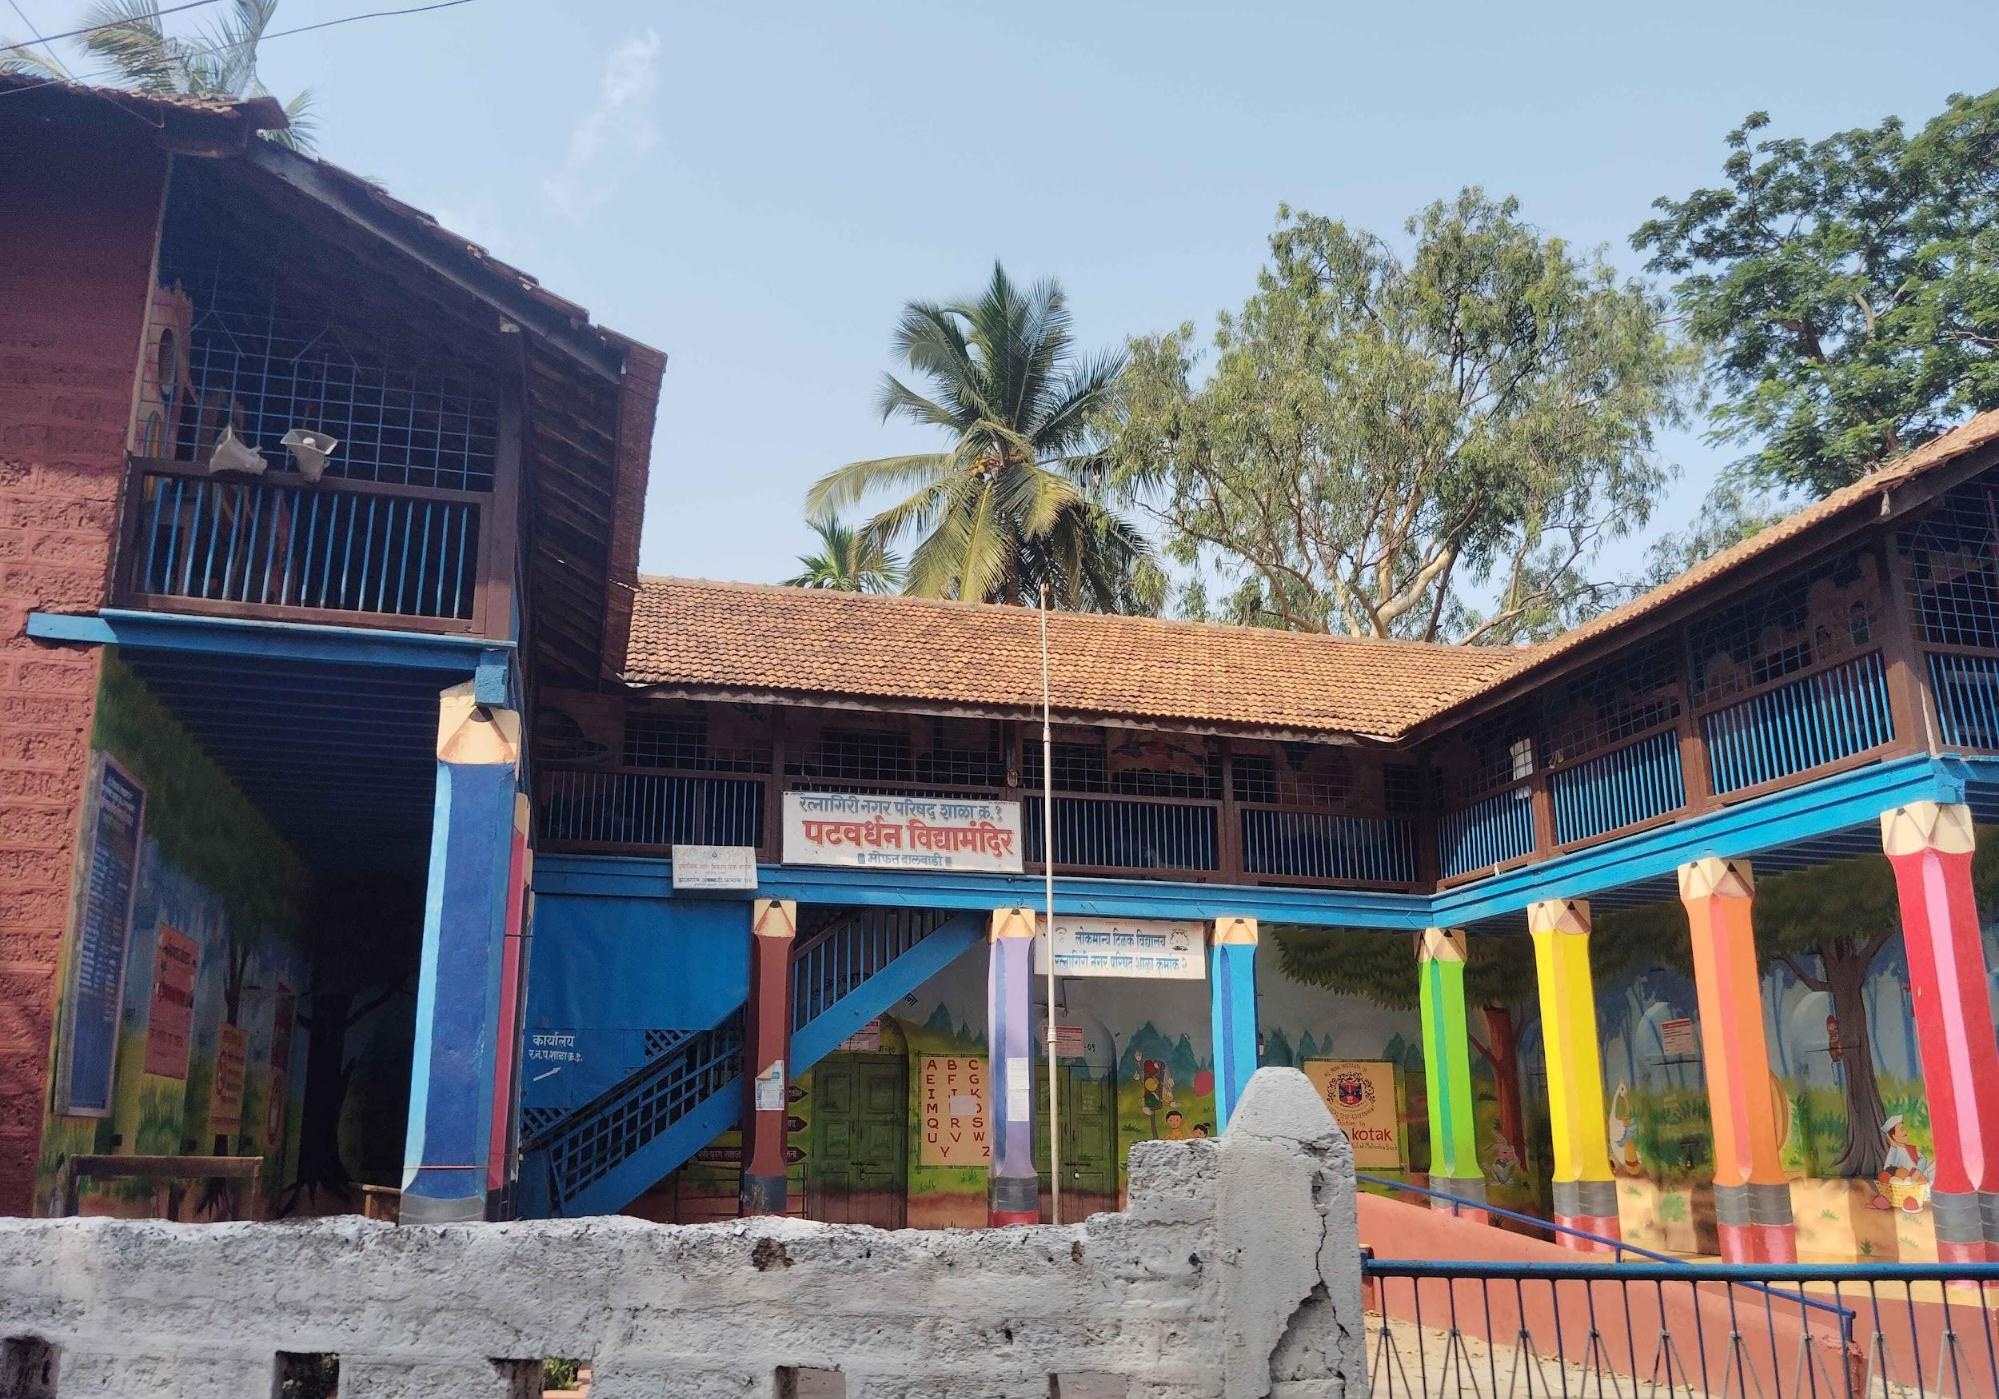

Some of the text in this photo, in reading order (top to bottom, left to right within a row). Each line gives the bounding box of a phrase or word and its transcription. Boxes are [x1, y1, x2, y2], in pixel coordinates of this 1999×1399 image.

[799, 794, 859, 815] रत्नागिरी
[861, 799, 891, 816] नगर
[893, 799, 936, 820] परिषद
[940, 803, 977, 820] शाळा
[801, 813, 1014, 858] पटवर्धन विद्यामंदिर
[1074, 926, 1111, 946] लोकमान्य
[1136, 929, 1167, 949] विद्यालय
[532, 1031, 576, 1048] कार्यालय
[927, 1060, 978, 1070] A B C
[926, 1074, 979, 1084] E F G
[928, 1089, 935, 1099] I
[927, 1104, 938, 1113] M
[927, 1118, 983, 1129] Q R S
[928, 1132, 984, 1143] U V W
[1351, 1128, 1393, 1141] kotak
[940, 1146, 950, 1157] Y
